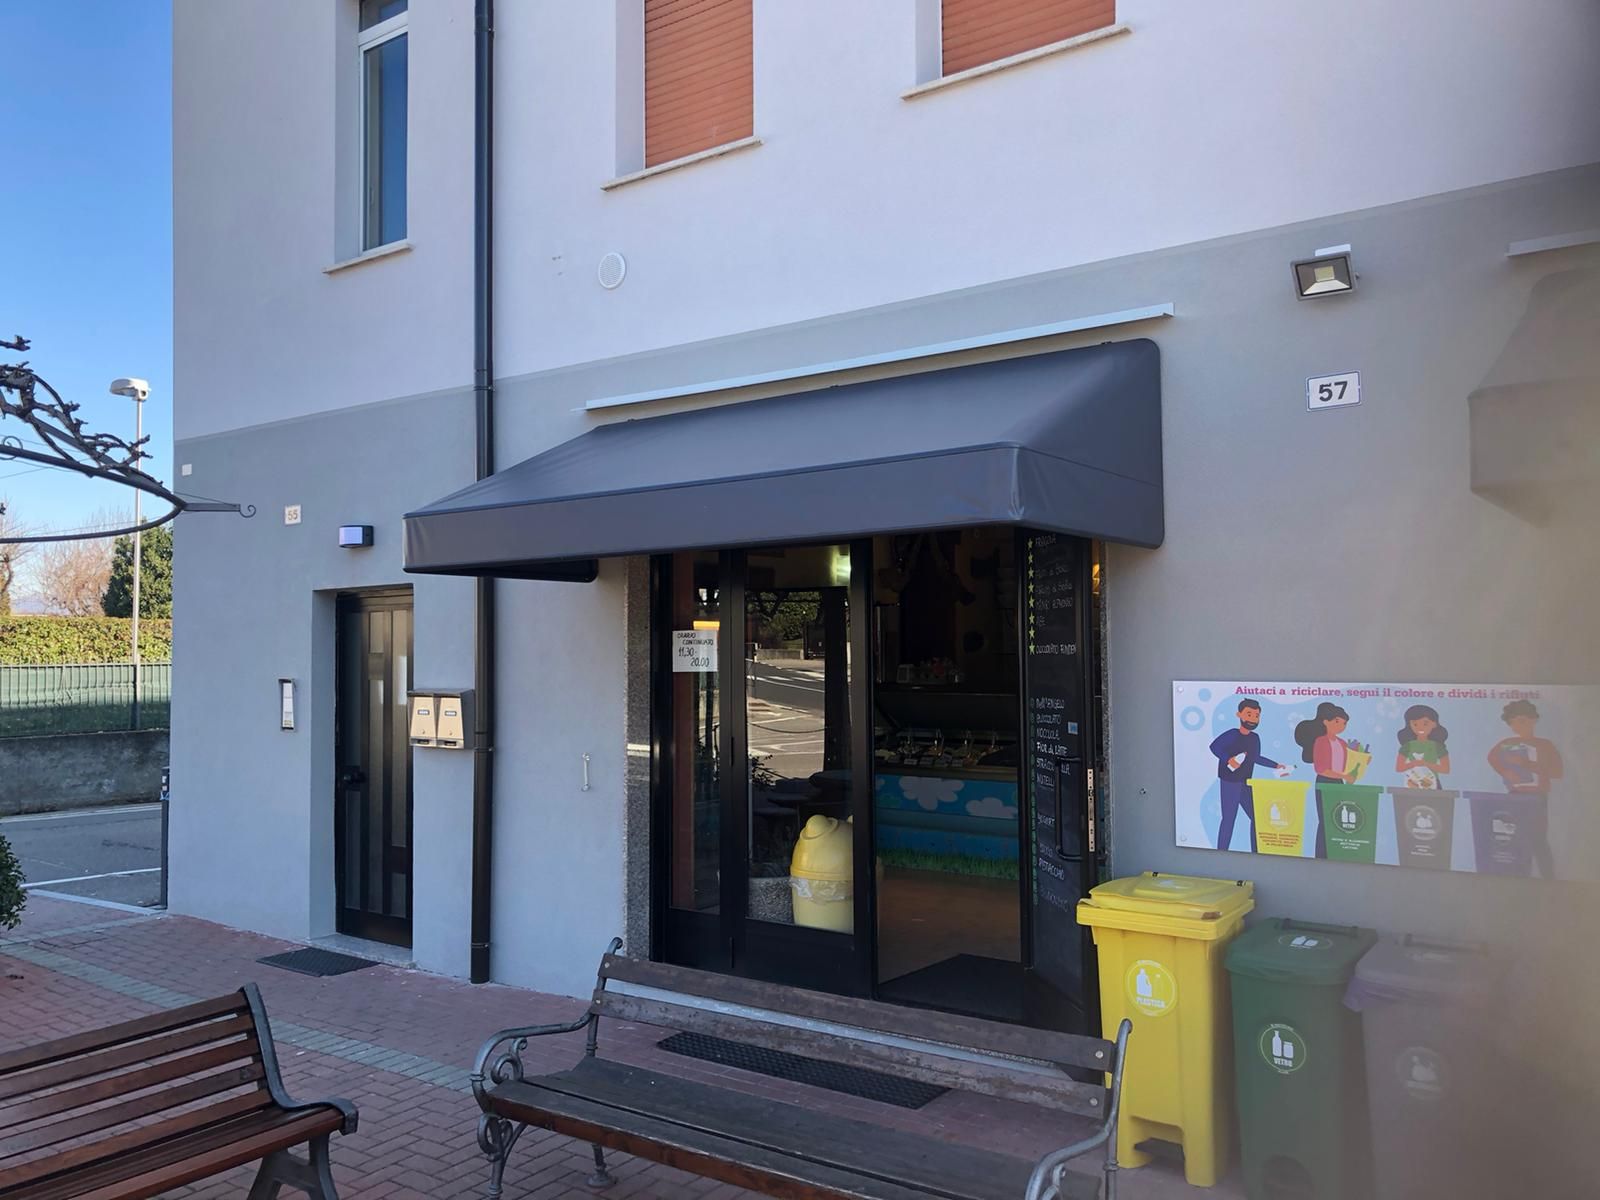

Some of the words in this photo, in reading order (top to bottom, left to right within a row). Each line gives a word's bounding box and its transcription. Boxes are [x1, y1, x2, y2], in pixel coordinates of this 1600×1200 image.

[1318, 381, 1348, 402] 57
[288, 509, 298, 521] 55
[1235, 686, 1276, 696] Aiutaci
[1291, 687, 1344, 698] riciclare,
[1347, 688, 1379, 699] segui
[1382, 687, 1390, 698] il
[1394, 688, 1433, 698] colore
[1448, 689, 1488, 699] dividi
[1499, 689, 1541, 700] rifiuti
[1037, 772, 1056, 787] NUTELL
[1273, 1056, 1293, 1067] VETRO
